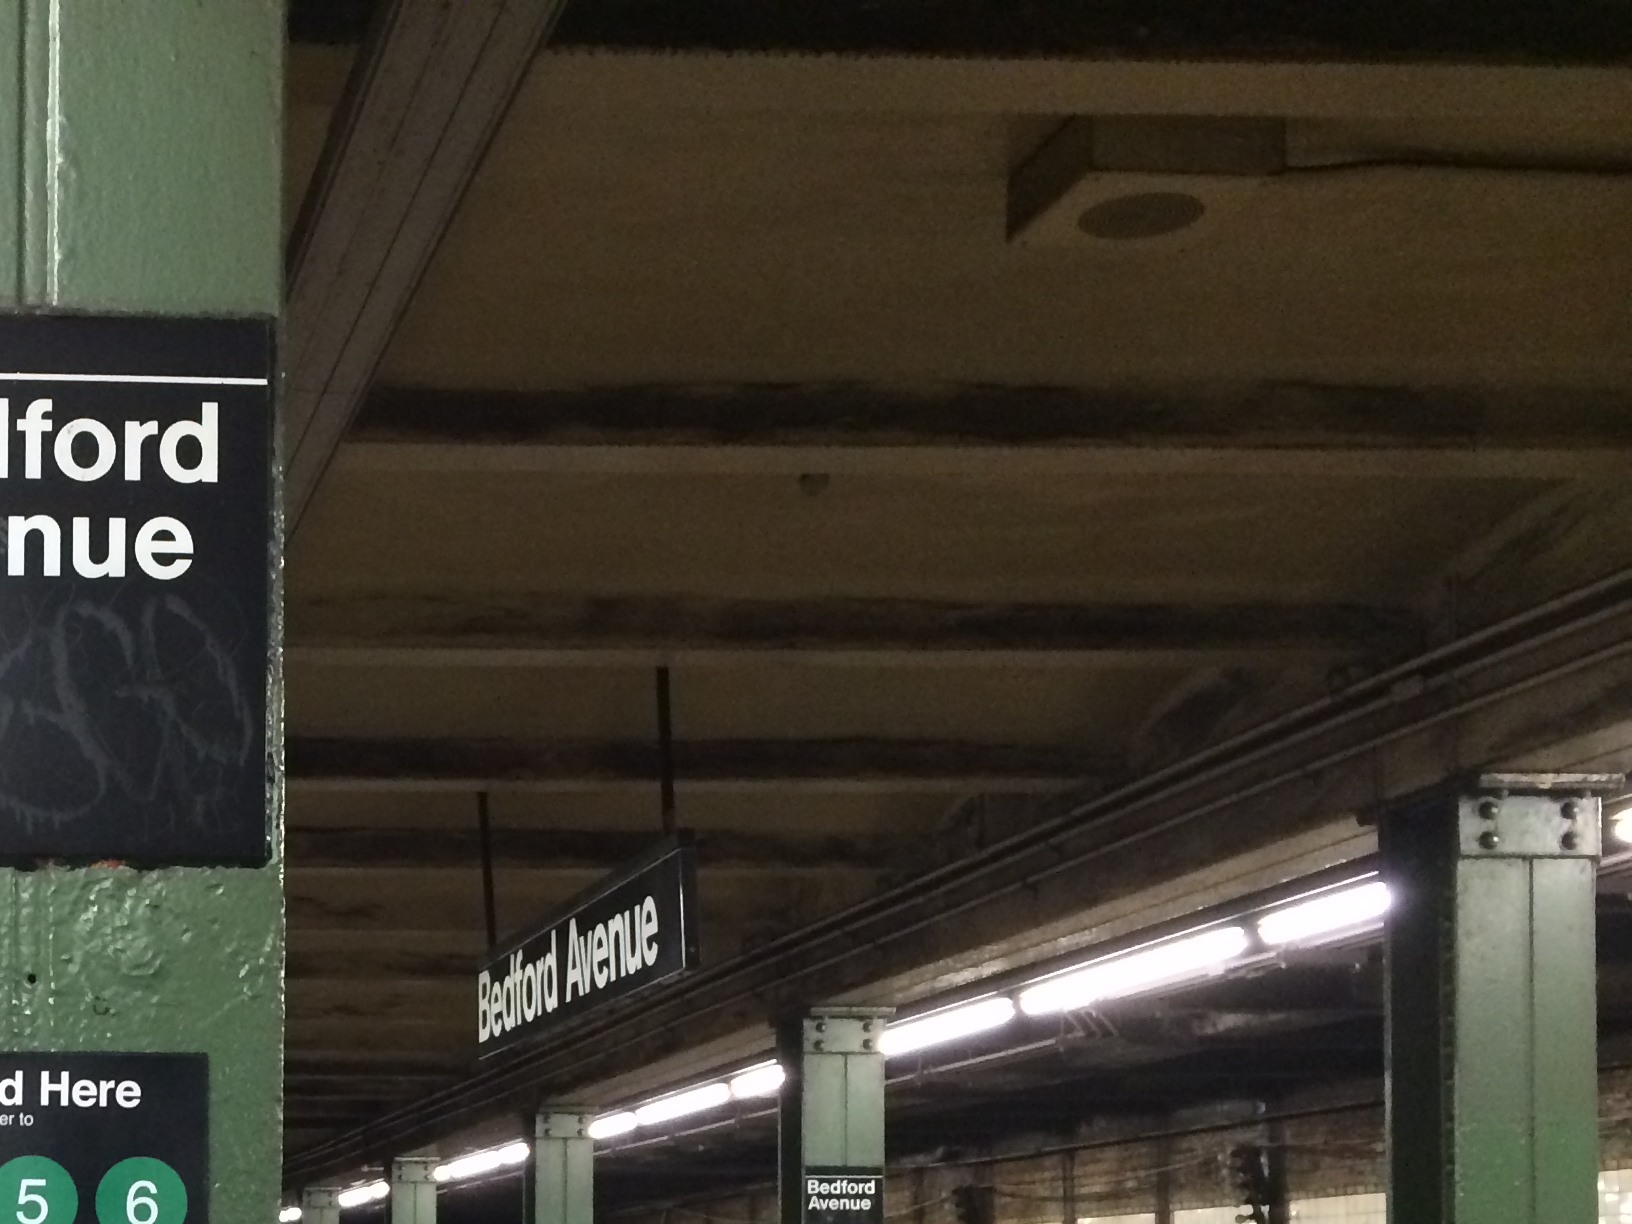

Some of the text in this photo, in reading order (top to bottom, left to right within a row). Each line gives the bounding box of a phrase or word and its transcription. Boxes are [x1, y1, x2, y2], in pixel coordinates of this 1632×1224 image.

[478, 896, 659, 1044] Bedford Avenue
[40, 1070, 142, 1109] Here
[18, 1112, 34, 1127] to
[807, 1179, 876, 1195] Bedford
[808, 1195, 872, 1211] Avenue
